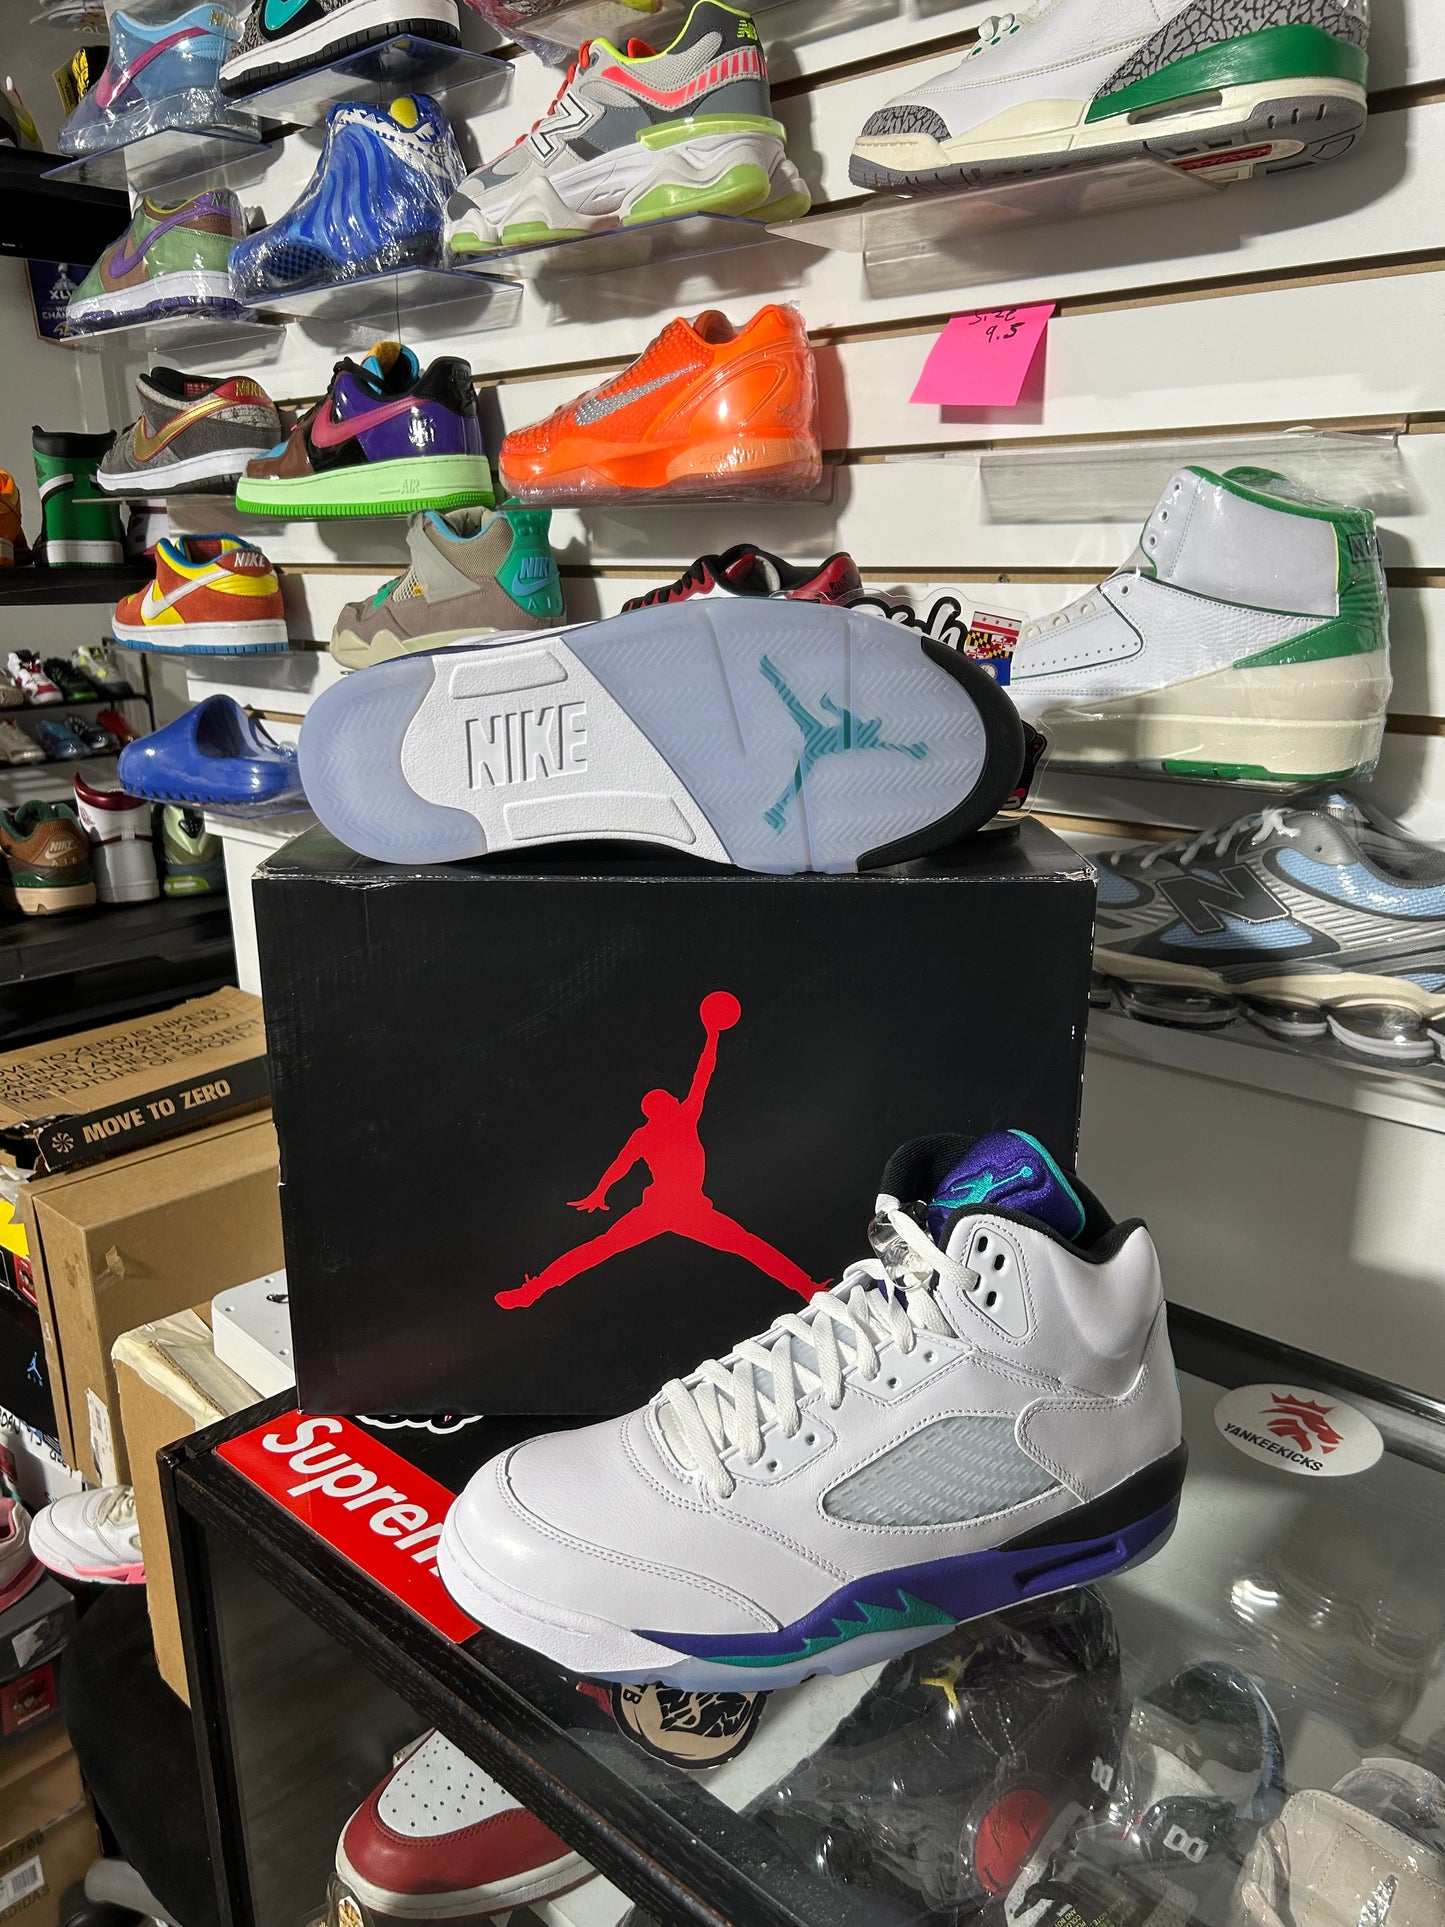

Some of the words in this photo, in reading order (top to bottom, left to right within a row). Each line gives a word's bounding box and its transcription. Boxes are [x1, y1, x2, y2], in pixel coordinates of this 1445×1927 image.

[986, 321, 1025, 343] 9.5
[401, 479, 420, 494] AIR
[234, 551, 266, 568] NIKE
[520, 556, 552, 579] NIK
[465, 701, 588, 790] NIKE
[50, 840, 74, 852] NIKE
[177, 1012, 230, 1034] ZERO
[33, 1053, 67, 1064] TO
[68, 1036, 127, 1056] ZERO
[135, 1034, 192, 1054] ZERO
[77, 1066, 111, 1078] TO
[83, 1108, 145, 1144] MOVE
[146, 1098, 176, 1121] TO
[179, 1079, 232, 1110] ZERO
[1223, 1422, 1323, 1472] YANKEEKICKS
